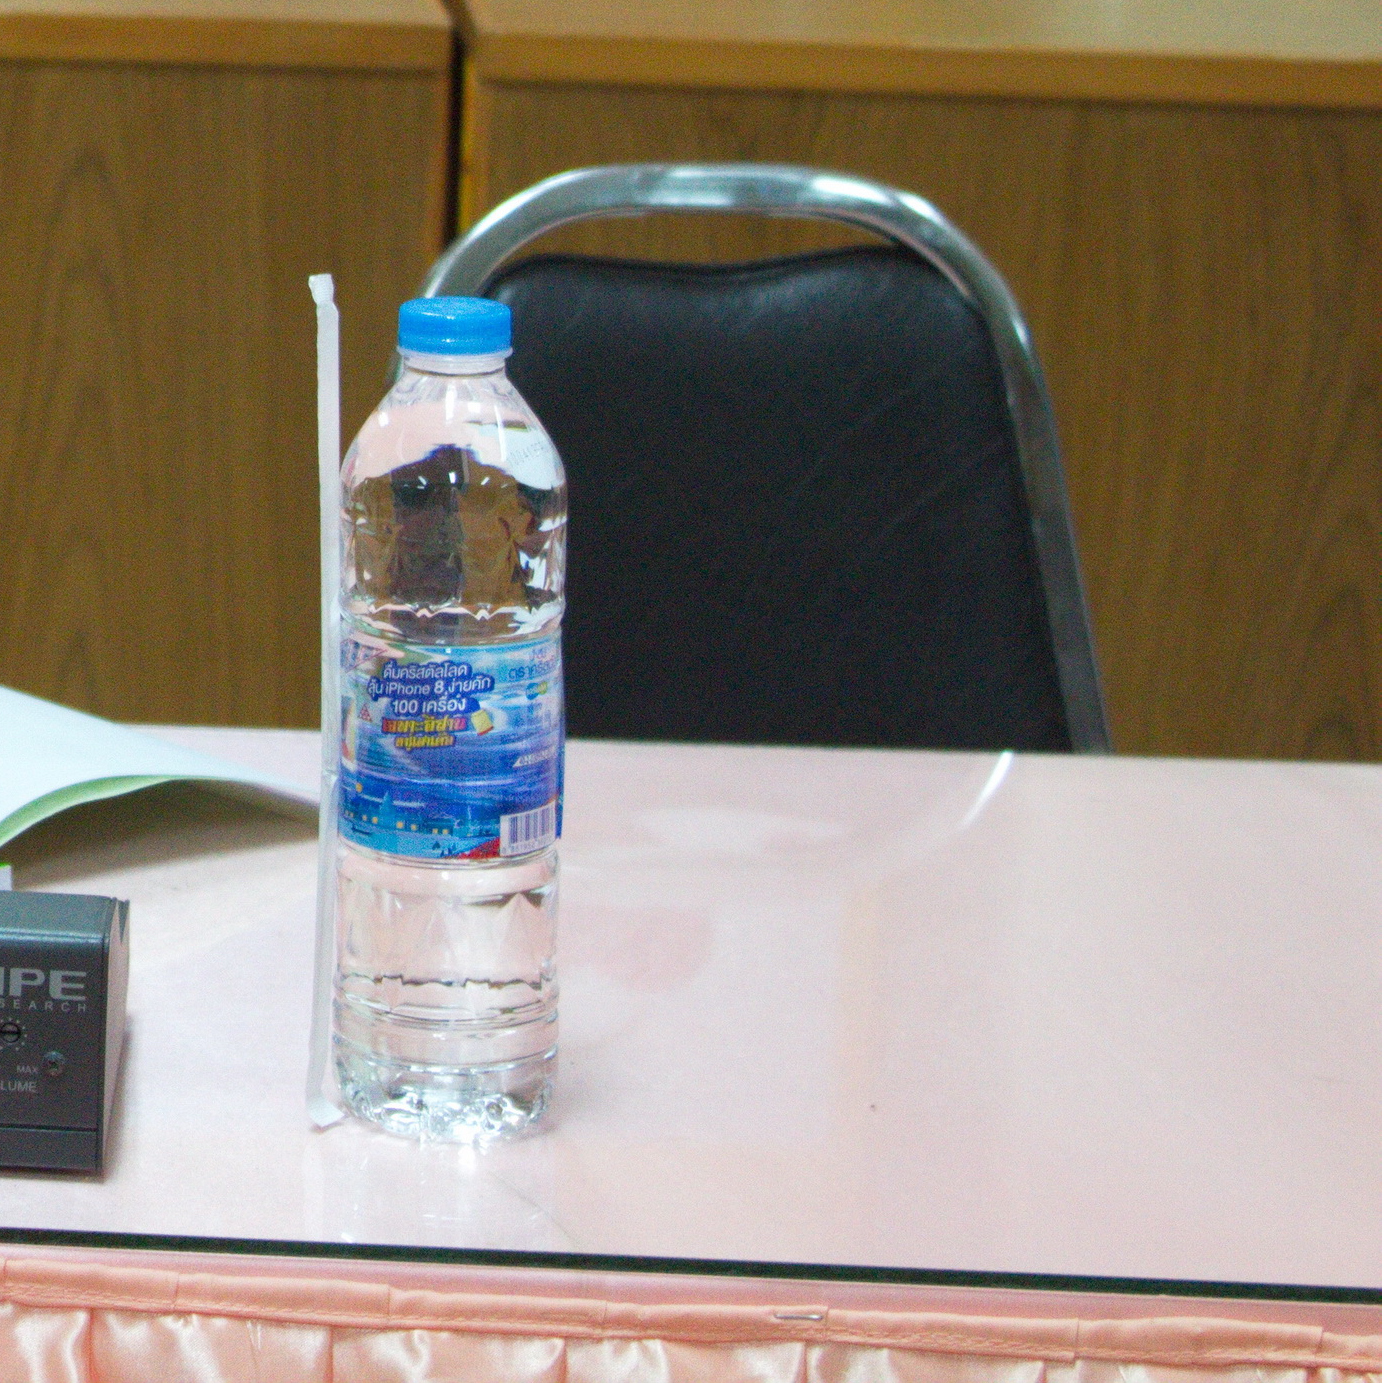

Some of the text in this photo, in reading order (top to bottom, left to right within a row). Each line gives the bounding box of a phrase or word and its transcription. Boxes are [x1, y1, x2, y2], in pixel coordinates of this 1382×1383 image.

[386, 682, 430, 695] iPhone
[434, 680, 444, 694] 8
[393, 691, 466, 714] 100 เครื่อง
